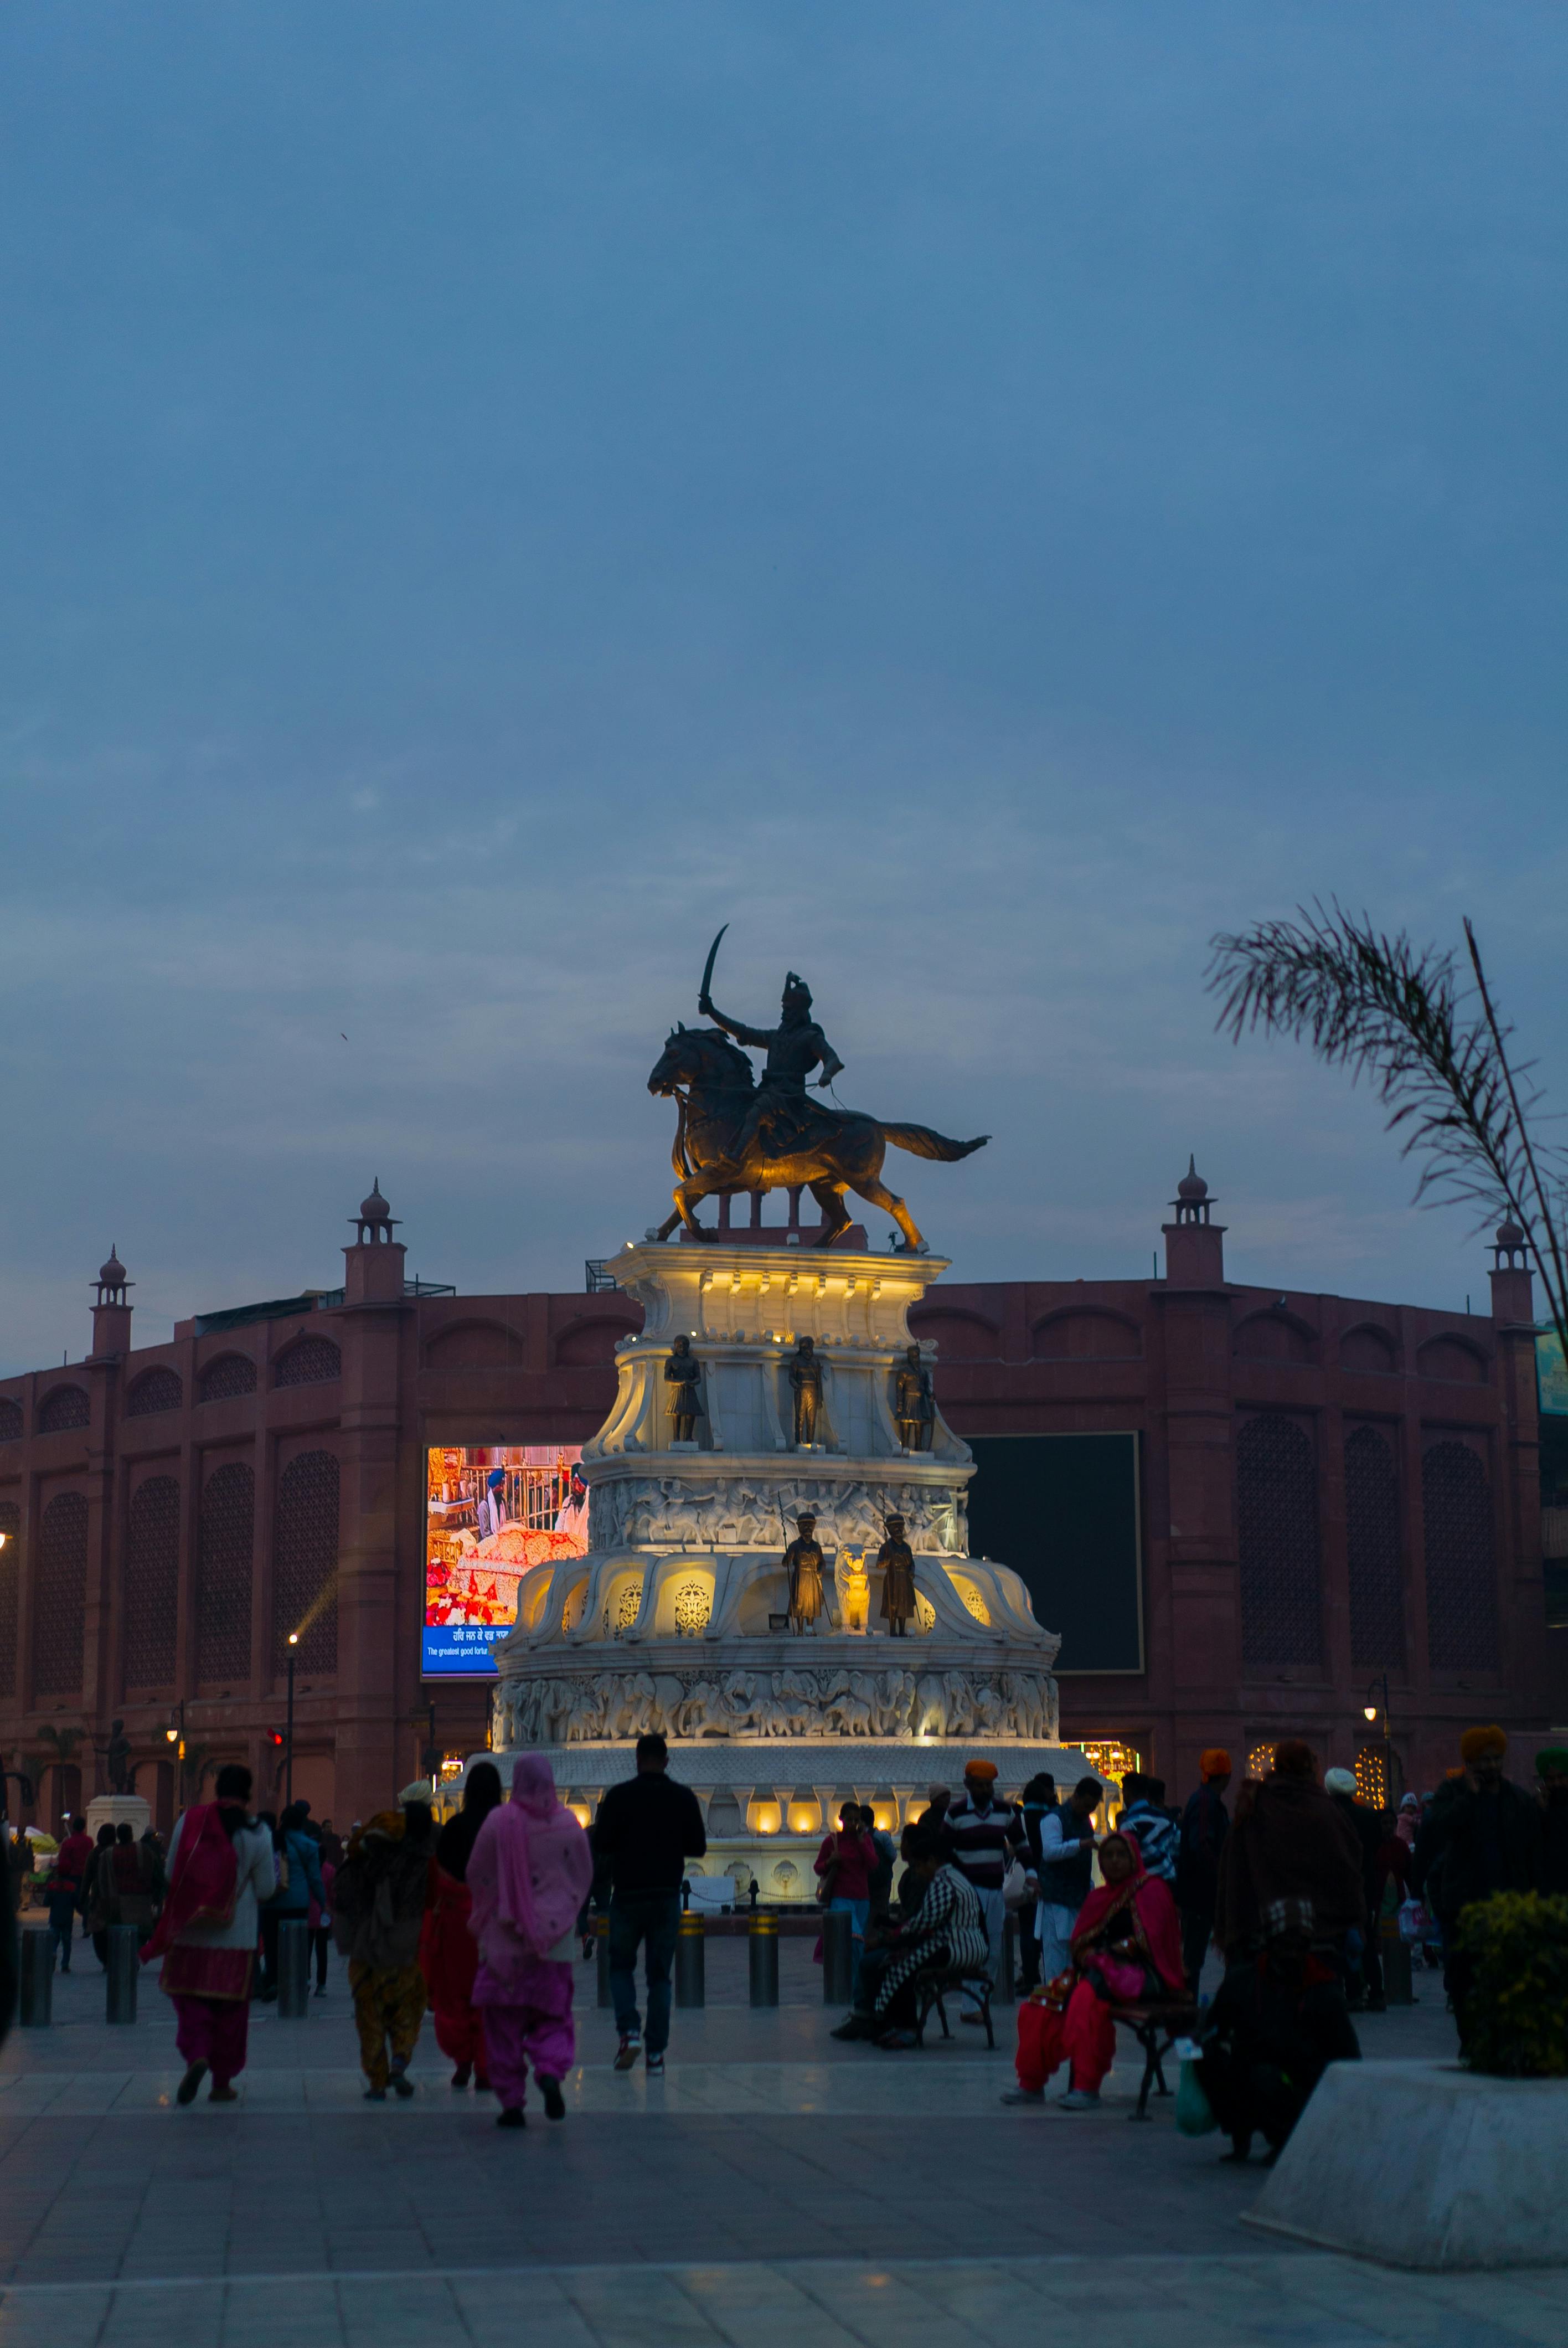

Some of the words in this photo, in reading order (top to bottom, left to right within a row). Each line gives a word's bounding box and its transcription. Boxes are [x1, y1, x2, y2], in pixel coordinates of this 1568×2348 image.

[427, 1647, 437, 1655] The
[439, 1647, 459, 1657] greatest
[460, 1647, 473, 1657] good
